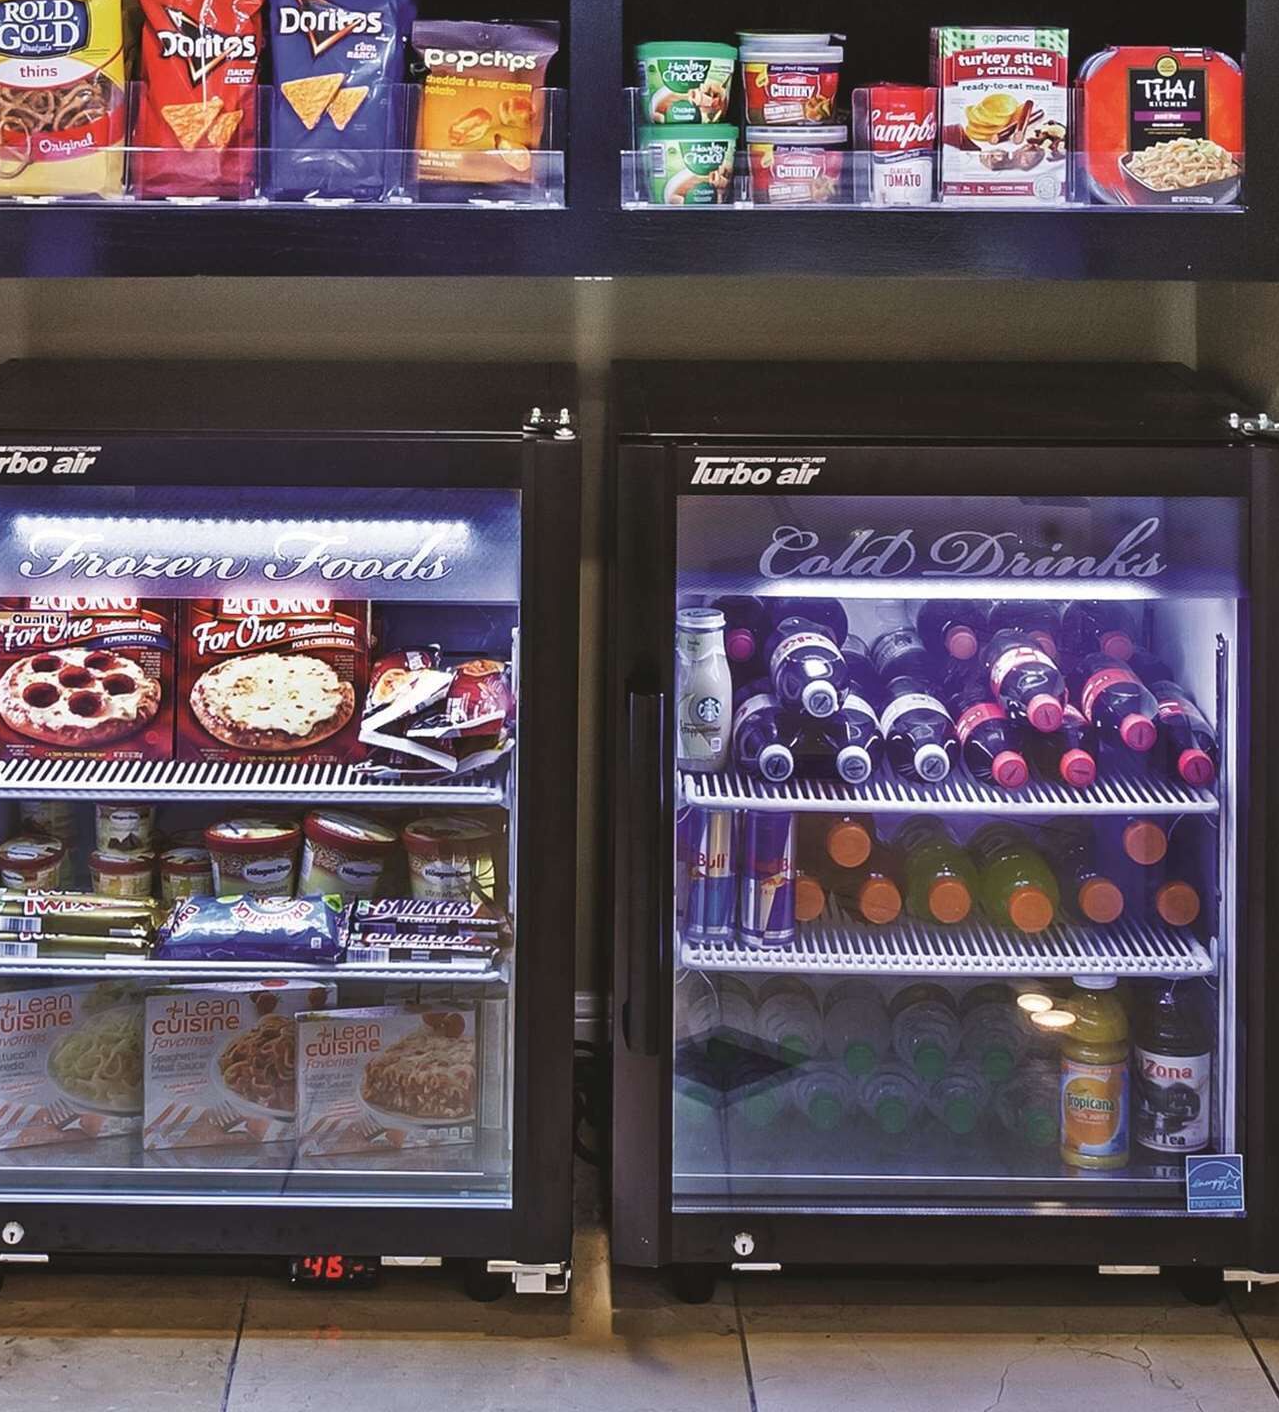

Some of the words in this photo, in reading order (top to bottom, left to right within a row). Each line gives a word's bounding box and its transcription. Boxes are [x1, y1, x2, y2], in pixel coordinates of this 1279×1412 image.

[3, 0, 74, 24] ROLD
[279, 7, 382, 34] Doritos
[157, 31, 256, 58] Doritos
[982, 34, 1030, 45] gopicnic
[424, 48, 537, 73] popchips
[958, 51, 1011, 67] turkey
[1014, 51, 1053, 67] stick
[19, 65, 58, 78] thins
[662, 70, 705, 82] Choice
[986, 66, 1034, 76] crunch
[962, 82, 1022, 91] ready-to-eat
[1025, 83, 1049, 91] meal
[1136, 78, 1195, 101] THAI
[39, 133, 95, 153] Original
[883, 174, 921, 187] TOMATO
[52, 451, 97, 474] air
[690, 457, 772, 485] Turbo
[776, 462, 821, 485] air
[19, 530, 249, 579] Frozen
[263, 529, 453, 581] Foods
[758, 525, 917, 579] Cold
[921, 516, 1168, 578] Drinks
[12, 613, 64, 626] Quality
[192, 620, 236, 656] For
[235, 615, 287, 648] One
[372, 899, 479, 918] SNICKERS
[18, 992, 73, 1015] Lean
[184, 998, 240, 1017] Lean
[333, 1024, 380, 1041] Lean
[1067, 1092, 1115, 1111] Tropicana
